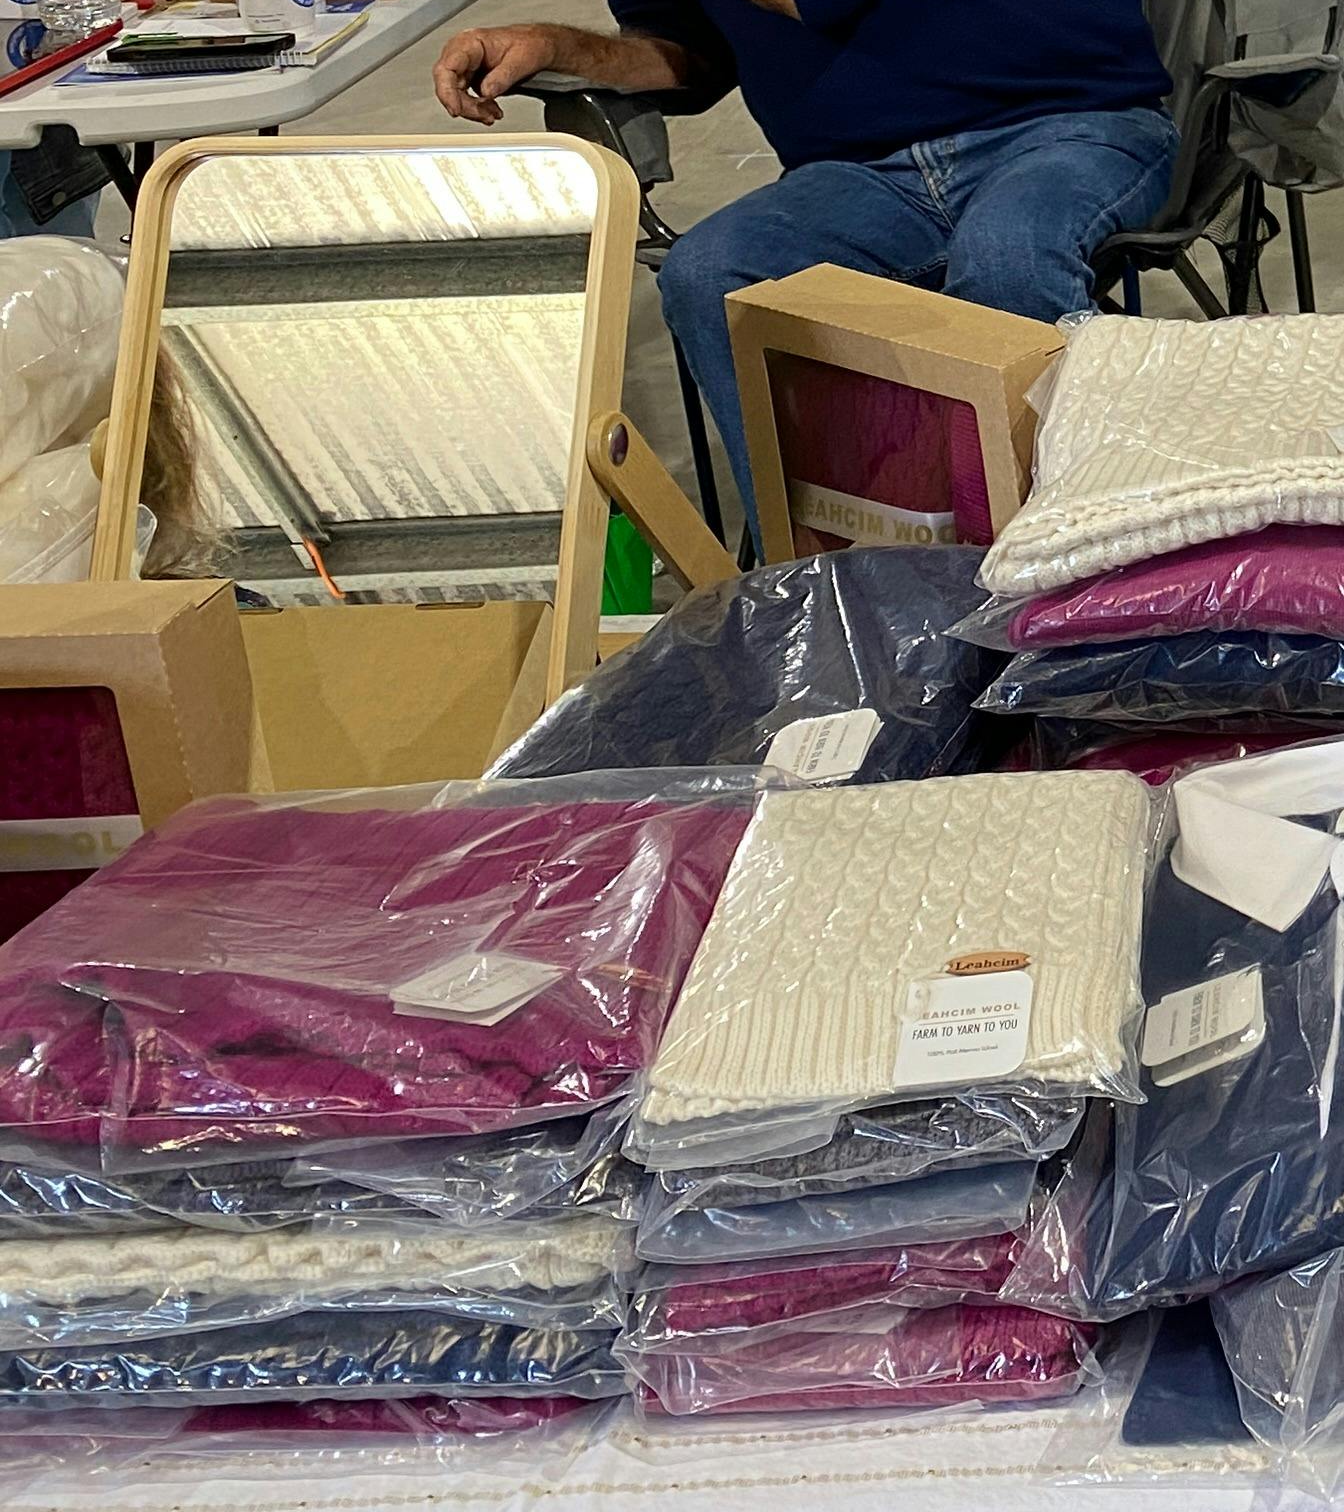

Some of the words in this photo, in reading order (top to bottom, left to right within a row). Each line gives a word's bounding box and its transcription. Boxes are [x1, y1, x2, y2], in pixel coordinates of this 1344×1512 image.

[954, 957, 1020, 971] Leahcim
[981, 1002, 1022, 1015] WOOL
[911, 1026, 939, 1041] FARM
[941, 1025, 954, 1038] TO
[957, 1023, 981, 1036] YARN
[984, 1021, 996, 1033] TO
[999, 1018, 1019, 1031] YOU
